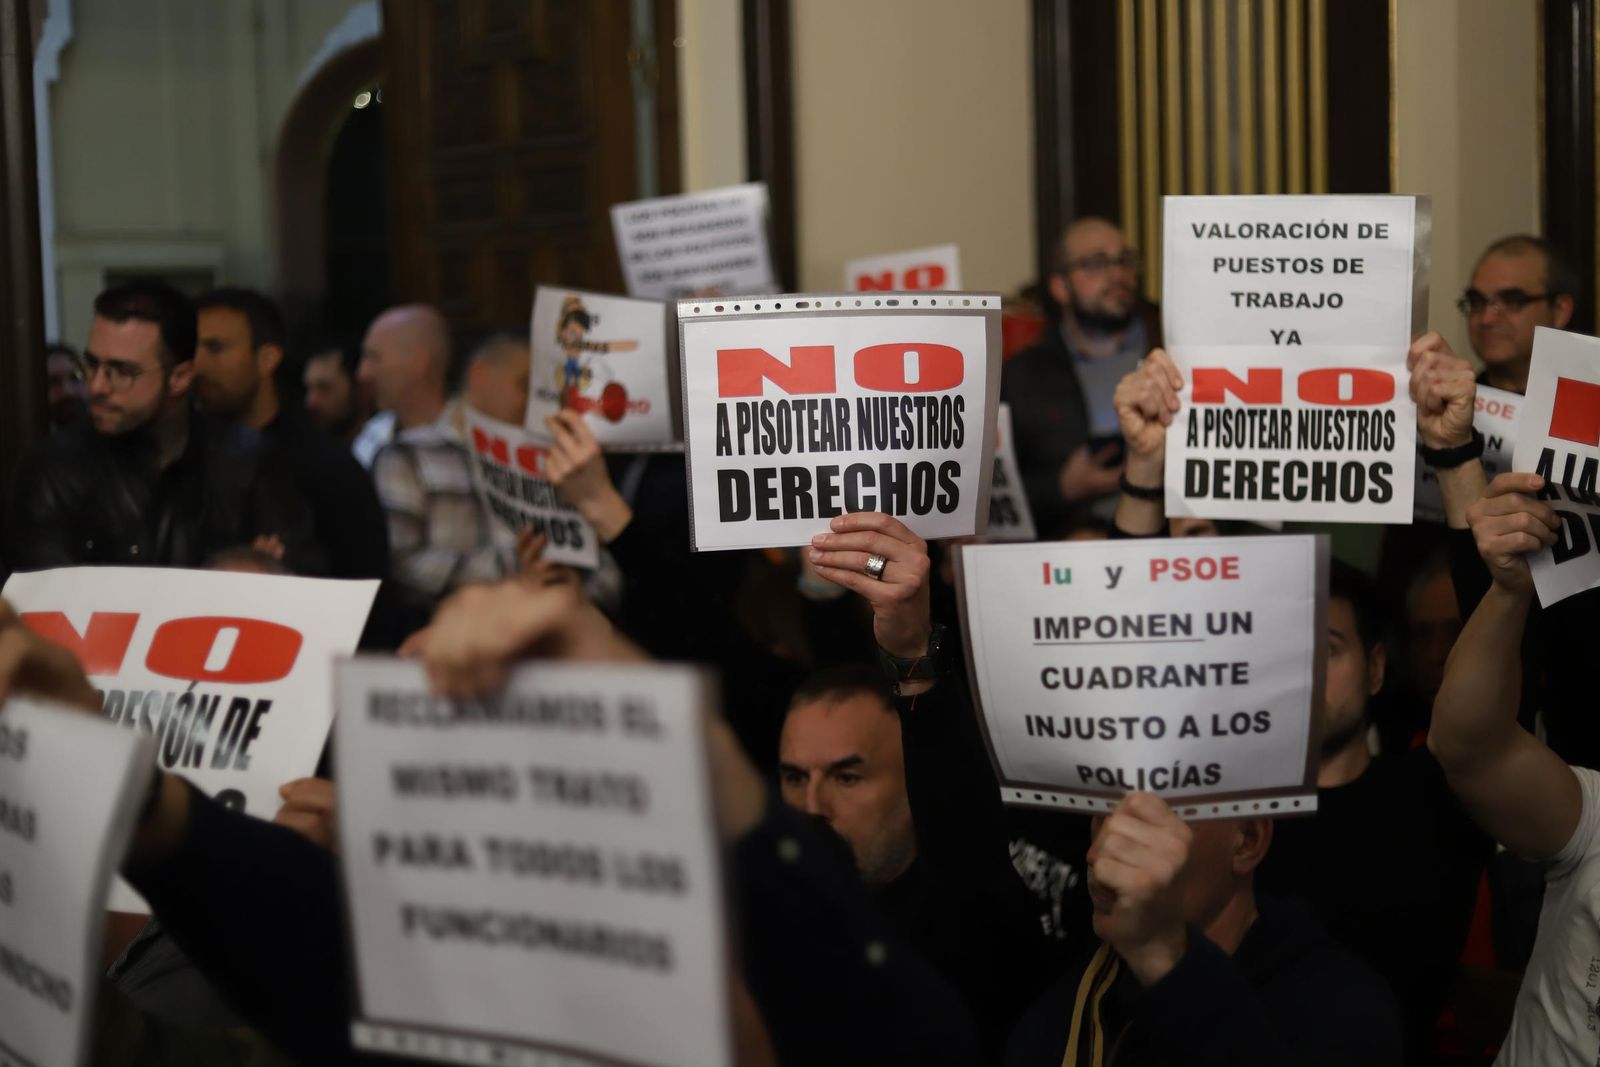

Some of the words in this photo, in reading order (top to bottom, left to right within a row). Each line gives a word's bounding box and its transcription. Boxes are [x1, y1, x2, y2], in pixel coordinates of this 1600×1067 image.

[1192, 219, 1349, 240] VALORACIÓN
[1357, 223, 1389, 240] DE
[856, 263, 945, 292] NO
[1212, 257, 1324, 274] PUESTOS
[1333, 258, 1364, 274] DE
[1231, 292, 1343, 309] TRABAJO
[1270, 330, 1302, 345] YA
[716, 342, 965, 398] NO
[1191, 367, 1395, 406] NO
[716, 402, 732, 456] A
[736, 397, 851, 456] PISOTEAR
[856, 394, 965, 451] NUESTROS
[1474, 397, 1515, 420] SOE
[1186, 408, 1199, 448] A
[1203, 408, 1292, 450] PISOTEAR
[1298, 409, 1396, 452] NUESTROS
[717, 460, 961, 523] DERECHOS
[1184, 459, 1393, 504] DERECHOS
[1105, 565, 1123, 590] y
[1149, 556, 1240, 582] PSOE
[1033, 613, 1193, 640] IMPONEN
[1206, 611, 1253, 636] UN
[20, 611, 304, 685] NO
[1041, 662, 1250, 690] CUADRANTE
[209, 696, 273, 771] DE
[1025, 715, 1167, 741] INJUSTO
[1178, 716, 1200, 739] A
[1211, 710, 1271, 737] LOS
[391, 765, 517, 805] MISMO
[527, 765, 649, 815] TRATO
[1076, 761, 1222, 791] POLICÍAS
[372, 833, 472, 870] PARA
[484, 839, 604, 885] TODOS
[614, 852, 690, 897] LOS
[400, 904, 674, 973] FUNCIONARIOS
